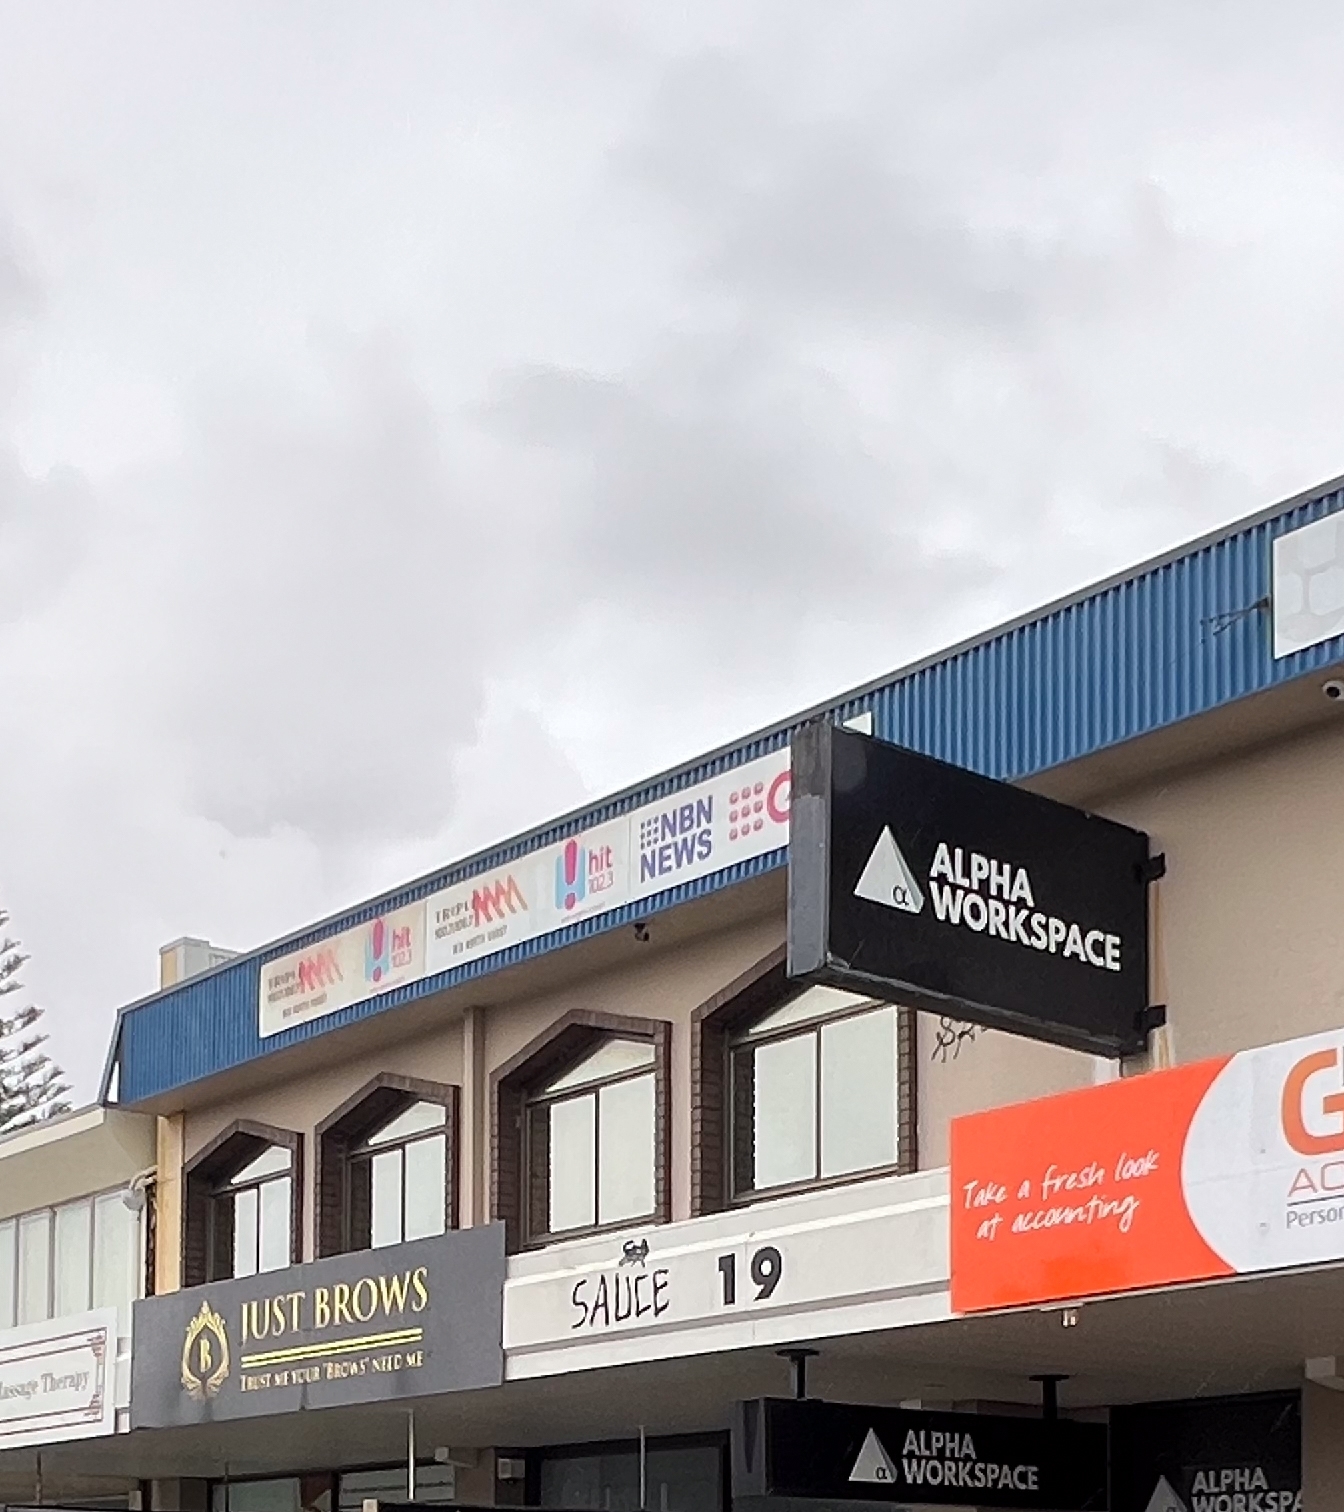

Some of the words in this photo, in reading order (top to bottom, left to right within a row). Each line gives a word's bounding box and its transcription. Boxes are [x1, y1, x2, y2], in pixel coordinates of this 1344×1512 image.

[661, 795, 713, 842] NBN
[588, 845, 612, 875] hit
[641, 829, 712, 883] NEWS
[929, 842, 1036, 908] ALPHA
[929, 880, 1122, 971] WORKSPACE
[963, 1179, 1007, 1209] Take
[1017, 1179, 1031, 1199] a
[1041, 1160, 1106, 1201] fresh
[1114, 1148, 1160, 1181] look
[976, 1212, 1004, 1241] at
[1011, 1194, 1140, 1234] accounting
[571, 1269, 670, 1329] SAUCE
[718, 1246, 783, 1306] 19
[241, 1290, 306, 1346] JUST
[314, 1266, 429, 1330] BROWS
[41, 1370, 90, 1394] Therapy
[240, 1372, 271, 1392] TRUST
[274, 1371, 288, 1386] ME
[292, 1366, 320, 1385] YOUR
[372, 1354, 402, 1373] NEED
[406, 1350, 424, 1368] ME
[902, 1429, 976, 1460] ALPHA
[902, 1459, 1039, 1491] WORKSPACE
[1191, 1467, 1268, 1494] ALPHA
